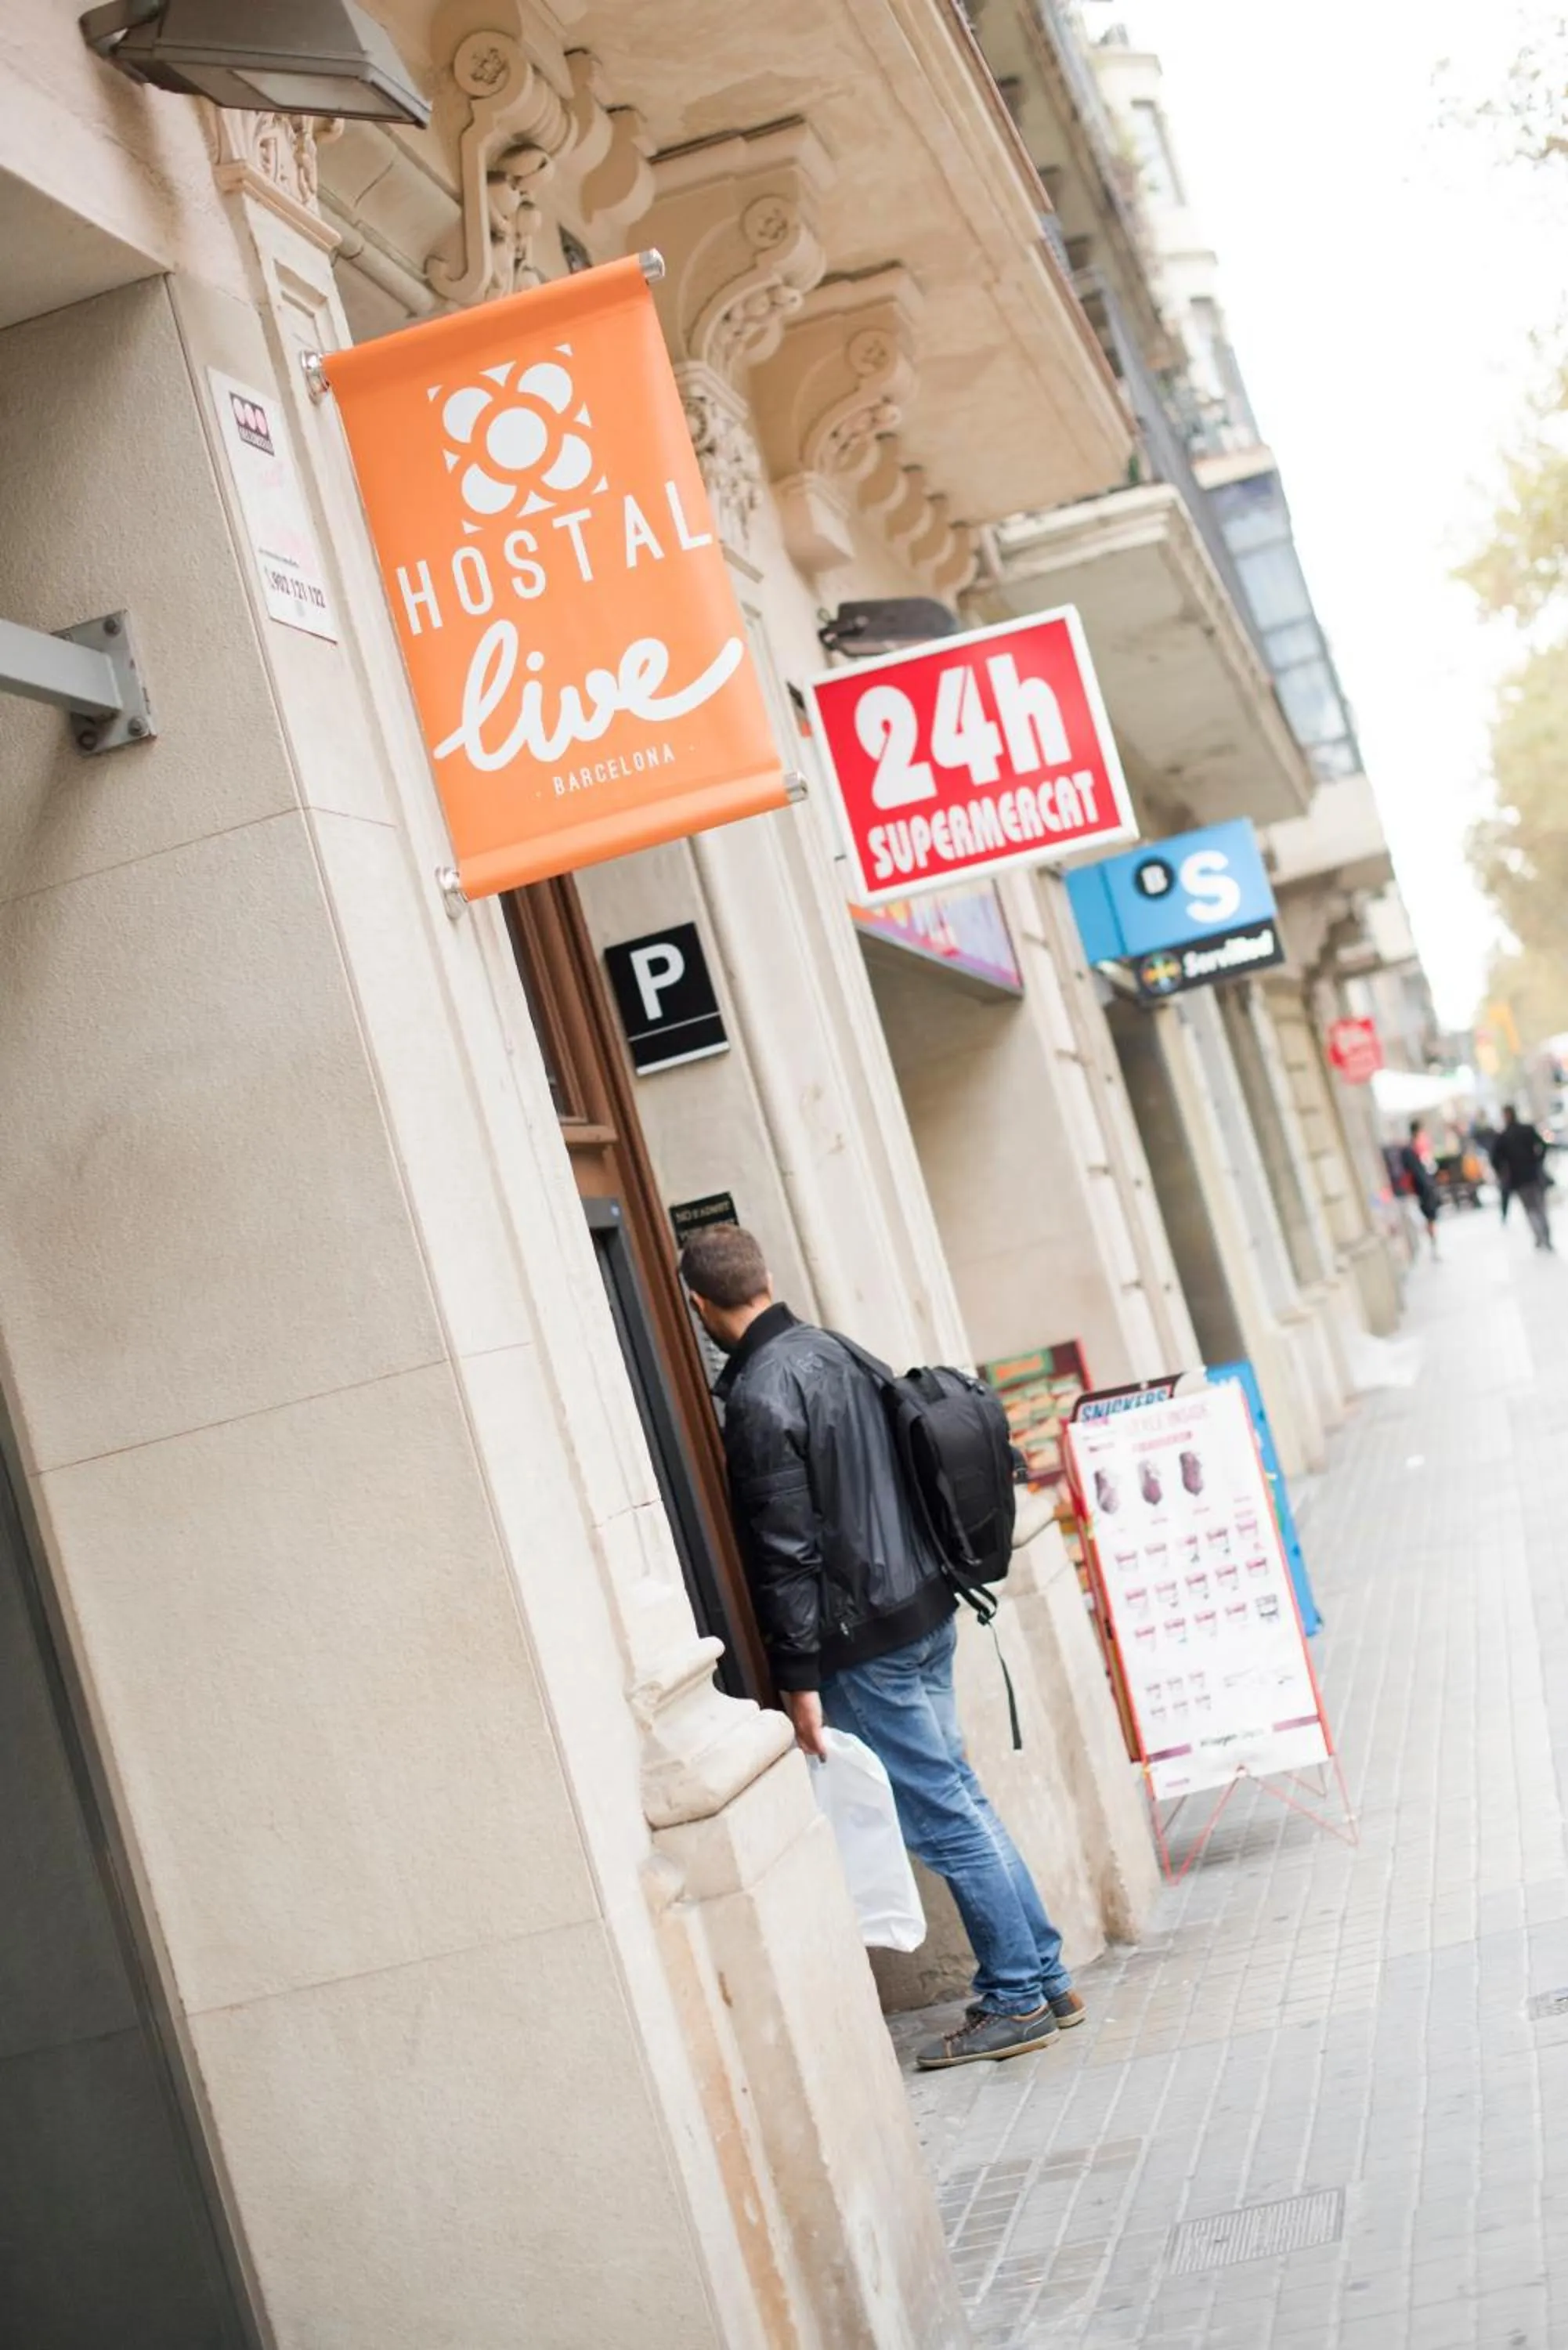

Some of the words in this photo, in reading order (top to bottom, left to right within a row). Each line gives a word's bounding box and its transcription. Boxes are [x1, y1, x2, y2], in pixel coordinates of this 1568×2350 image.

[396, 480, 713, 635] HOSTAL
[433, 620, 744, 772] live
[854, 653, 1072, 811] 24h
[553, 743, 675, 797] BARCELONA
[867, 769, 1098, 880] SUPERMERCAT
[630, 942, 685, 1021] P
